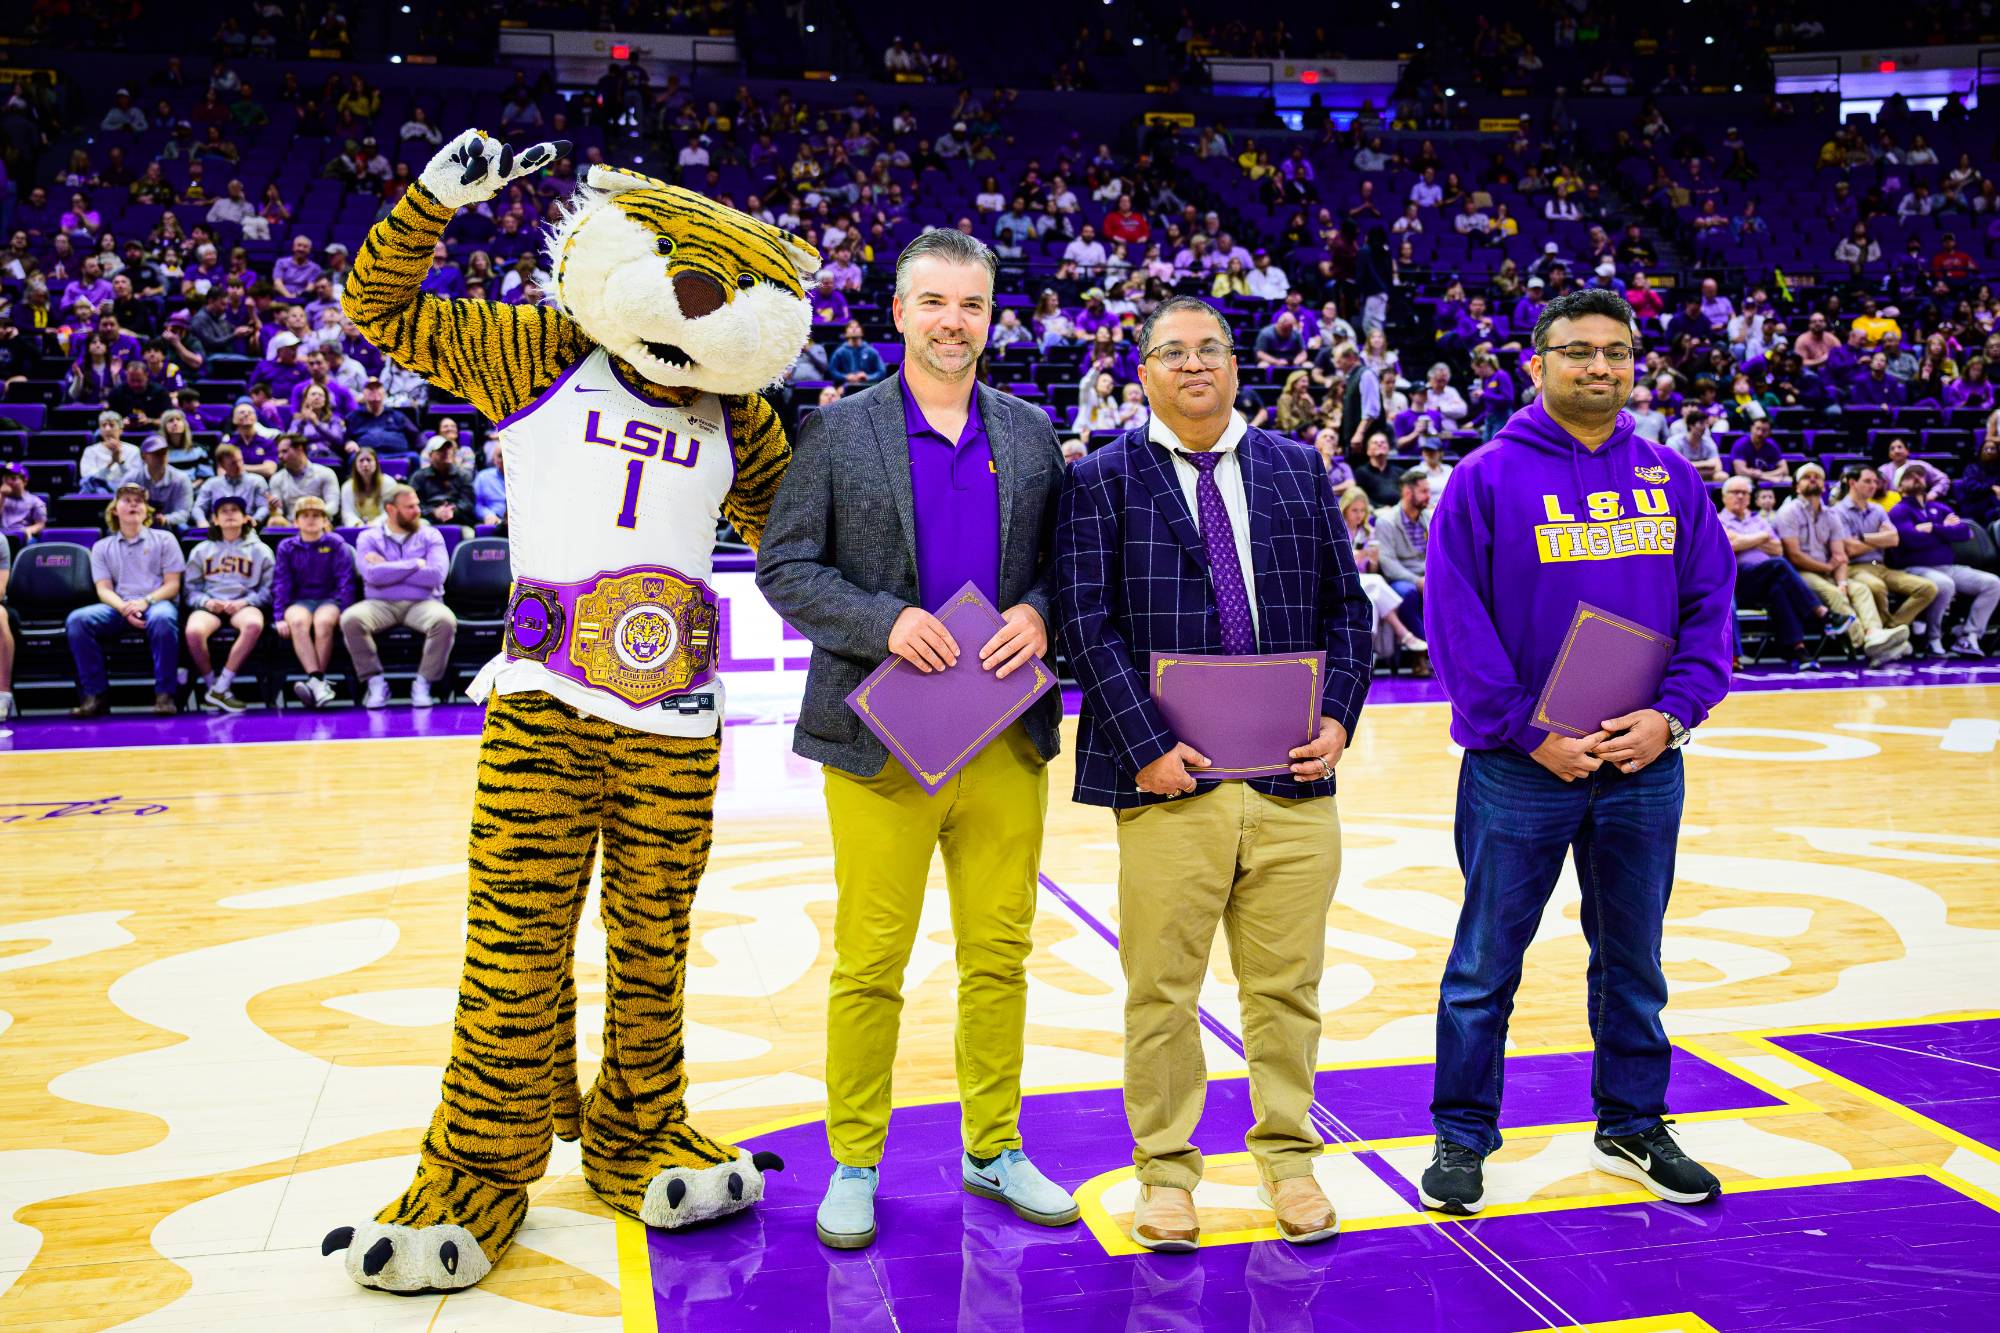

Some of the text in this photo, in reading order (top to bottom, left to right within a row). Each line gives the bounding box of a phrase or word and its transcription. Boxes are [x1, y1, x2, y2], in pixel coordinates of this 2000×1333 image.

[584, 410, 701, 469] LSU
[616, 458, 645, 530] 1
[1543, 489, 1670, 522] LSU
[1540, 520, 1675, 558] TIGERS
[203, 556, 255, 578] LSU
[518, 614, 543, 632] LSU
[622, 671, 661, 681] GEAUX TIGERS
